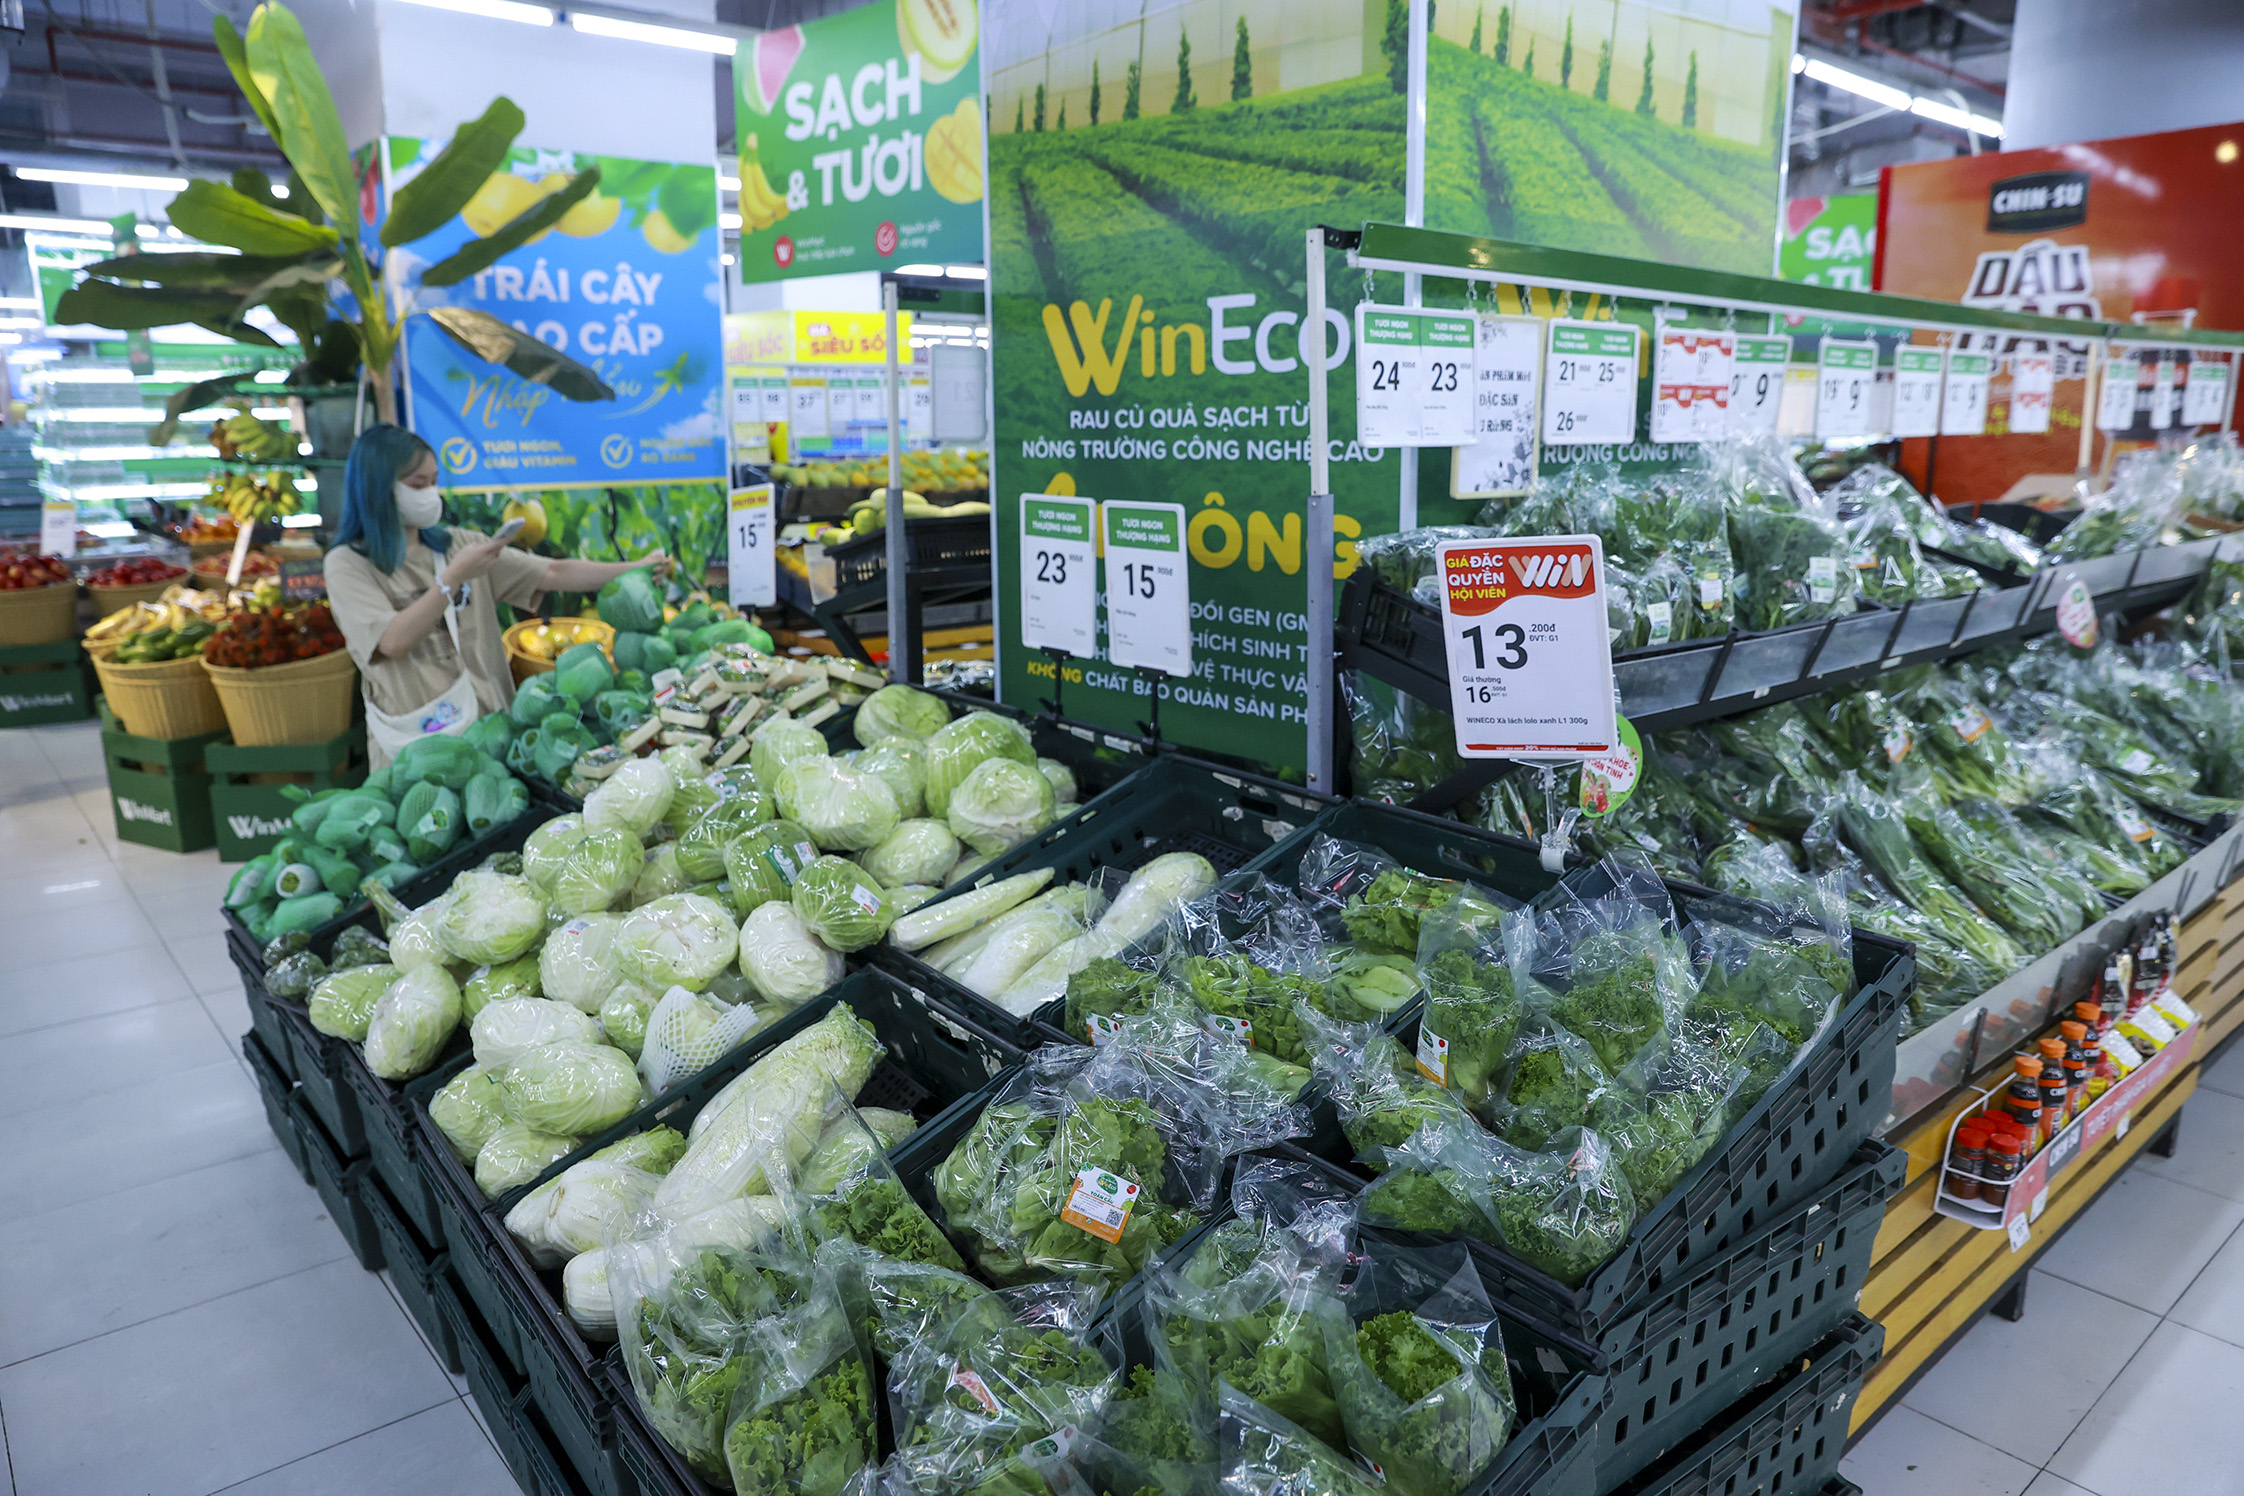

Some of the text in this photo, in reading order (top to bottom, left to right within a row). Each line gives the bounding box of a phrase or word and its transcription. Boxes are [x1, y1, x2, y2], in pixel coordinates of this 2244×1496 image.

[785, 52, 922, 142] SẠCH
[785, 130, 923, 212] & TƯƠI
[473, 258, 664, 306] TRÁI CÂY
[578, 308, 665, 357] CẤP
[1041, 293, 1351, 398] WinEco
[1372, 360, 1400, 391] 24
[1431, 362, 1458, 392] 23
[1559, 360, 1615, 382] 21 25
[1754, 371, 1770, 408] 9
[1069, 400, 1311, 432] RAU CỦ QUẢ SẠCH TỪ
[1557, 411, 1574, 431] 26
[1021, 435, 1077, 459] NÔNG
[1080, 434, 1168, 460] TRƯỜNG
[1172, 434, 1240, 461] CÔNG
[1327, 439, 1385, 463] CAO
[739, 523, 757, 550] 15
[1036, 551, 1066, 584] 23
[1446, 555, 1469, 569] GIÁ
[1470, 552, 1504, 569] ĐẶC
[1123, 563, 1156, 599] 15
[1448, 566, 1505, 587] QUYỀN
[1450, 586, 1507, 601] HỘI VIÊN
[1228, 606, 1270, 628] GEN
[1190, 629, 1237, 653] HÍCH
[1242, 638, 1290, 661] SINH
[1462, 623, 1528, 670] 13
[1220, 664, 1275, 692] THỰC
[1462, 675, 1502, 684] Giá thường
[1085, 670, 1129, 693] CHẤT
[1174, 686, 1229, 711] QUẢN
[1234, 693, 1275, 719] SẢN
[1466, 686, 1491, 704] 16
[1497, 716, 1506, 724] Xà
[1507, 716, 1523, 724] lách
[1524, 716, 1538, 724] lolo
[1569, 717, 1588, 725] 300g
[117, 796, 173, 826] WinMart
